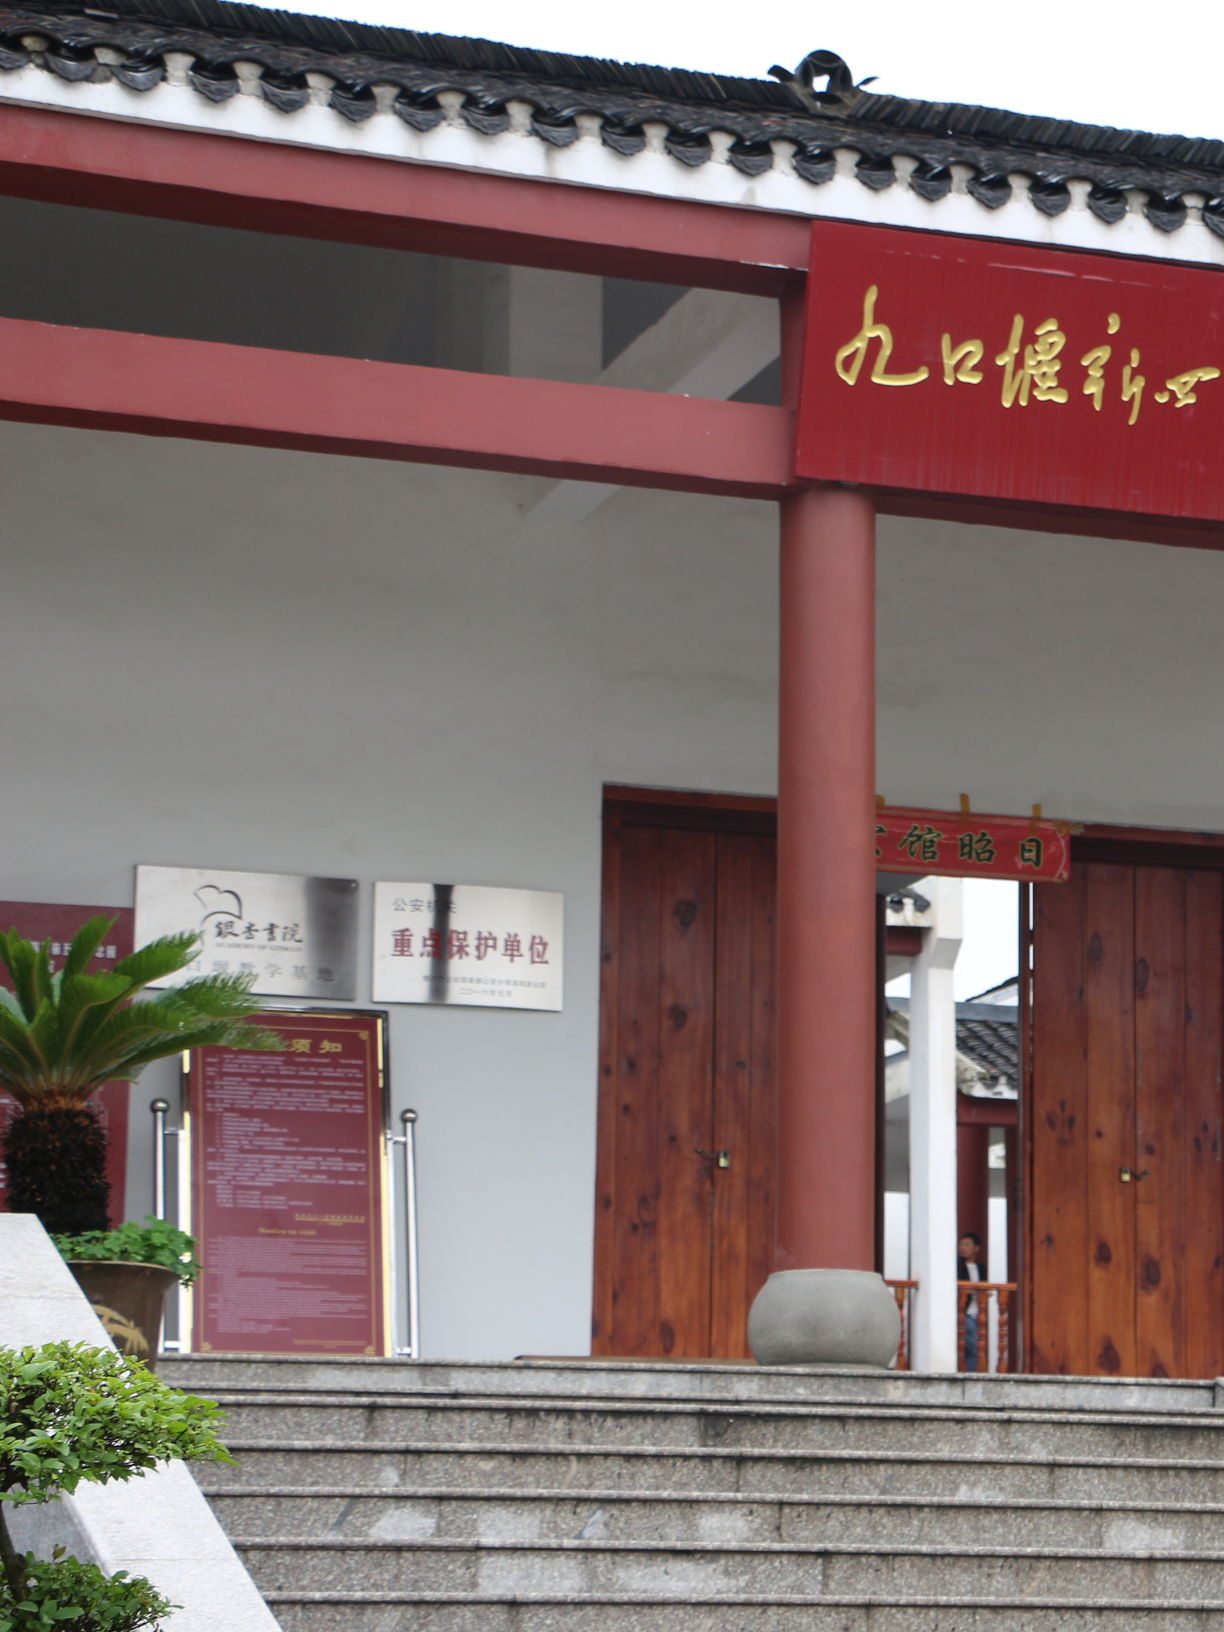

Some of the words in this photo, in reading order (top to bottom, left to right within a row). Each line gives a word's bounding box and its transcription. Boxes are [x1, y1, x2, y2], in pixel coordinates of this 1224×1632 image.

[391, 927, 550, 965] 重点保护单位
